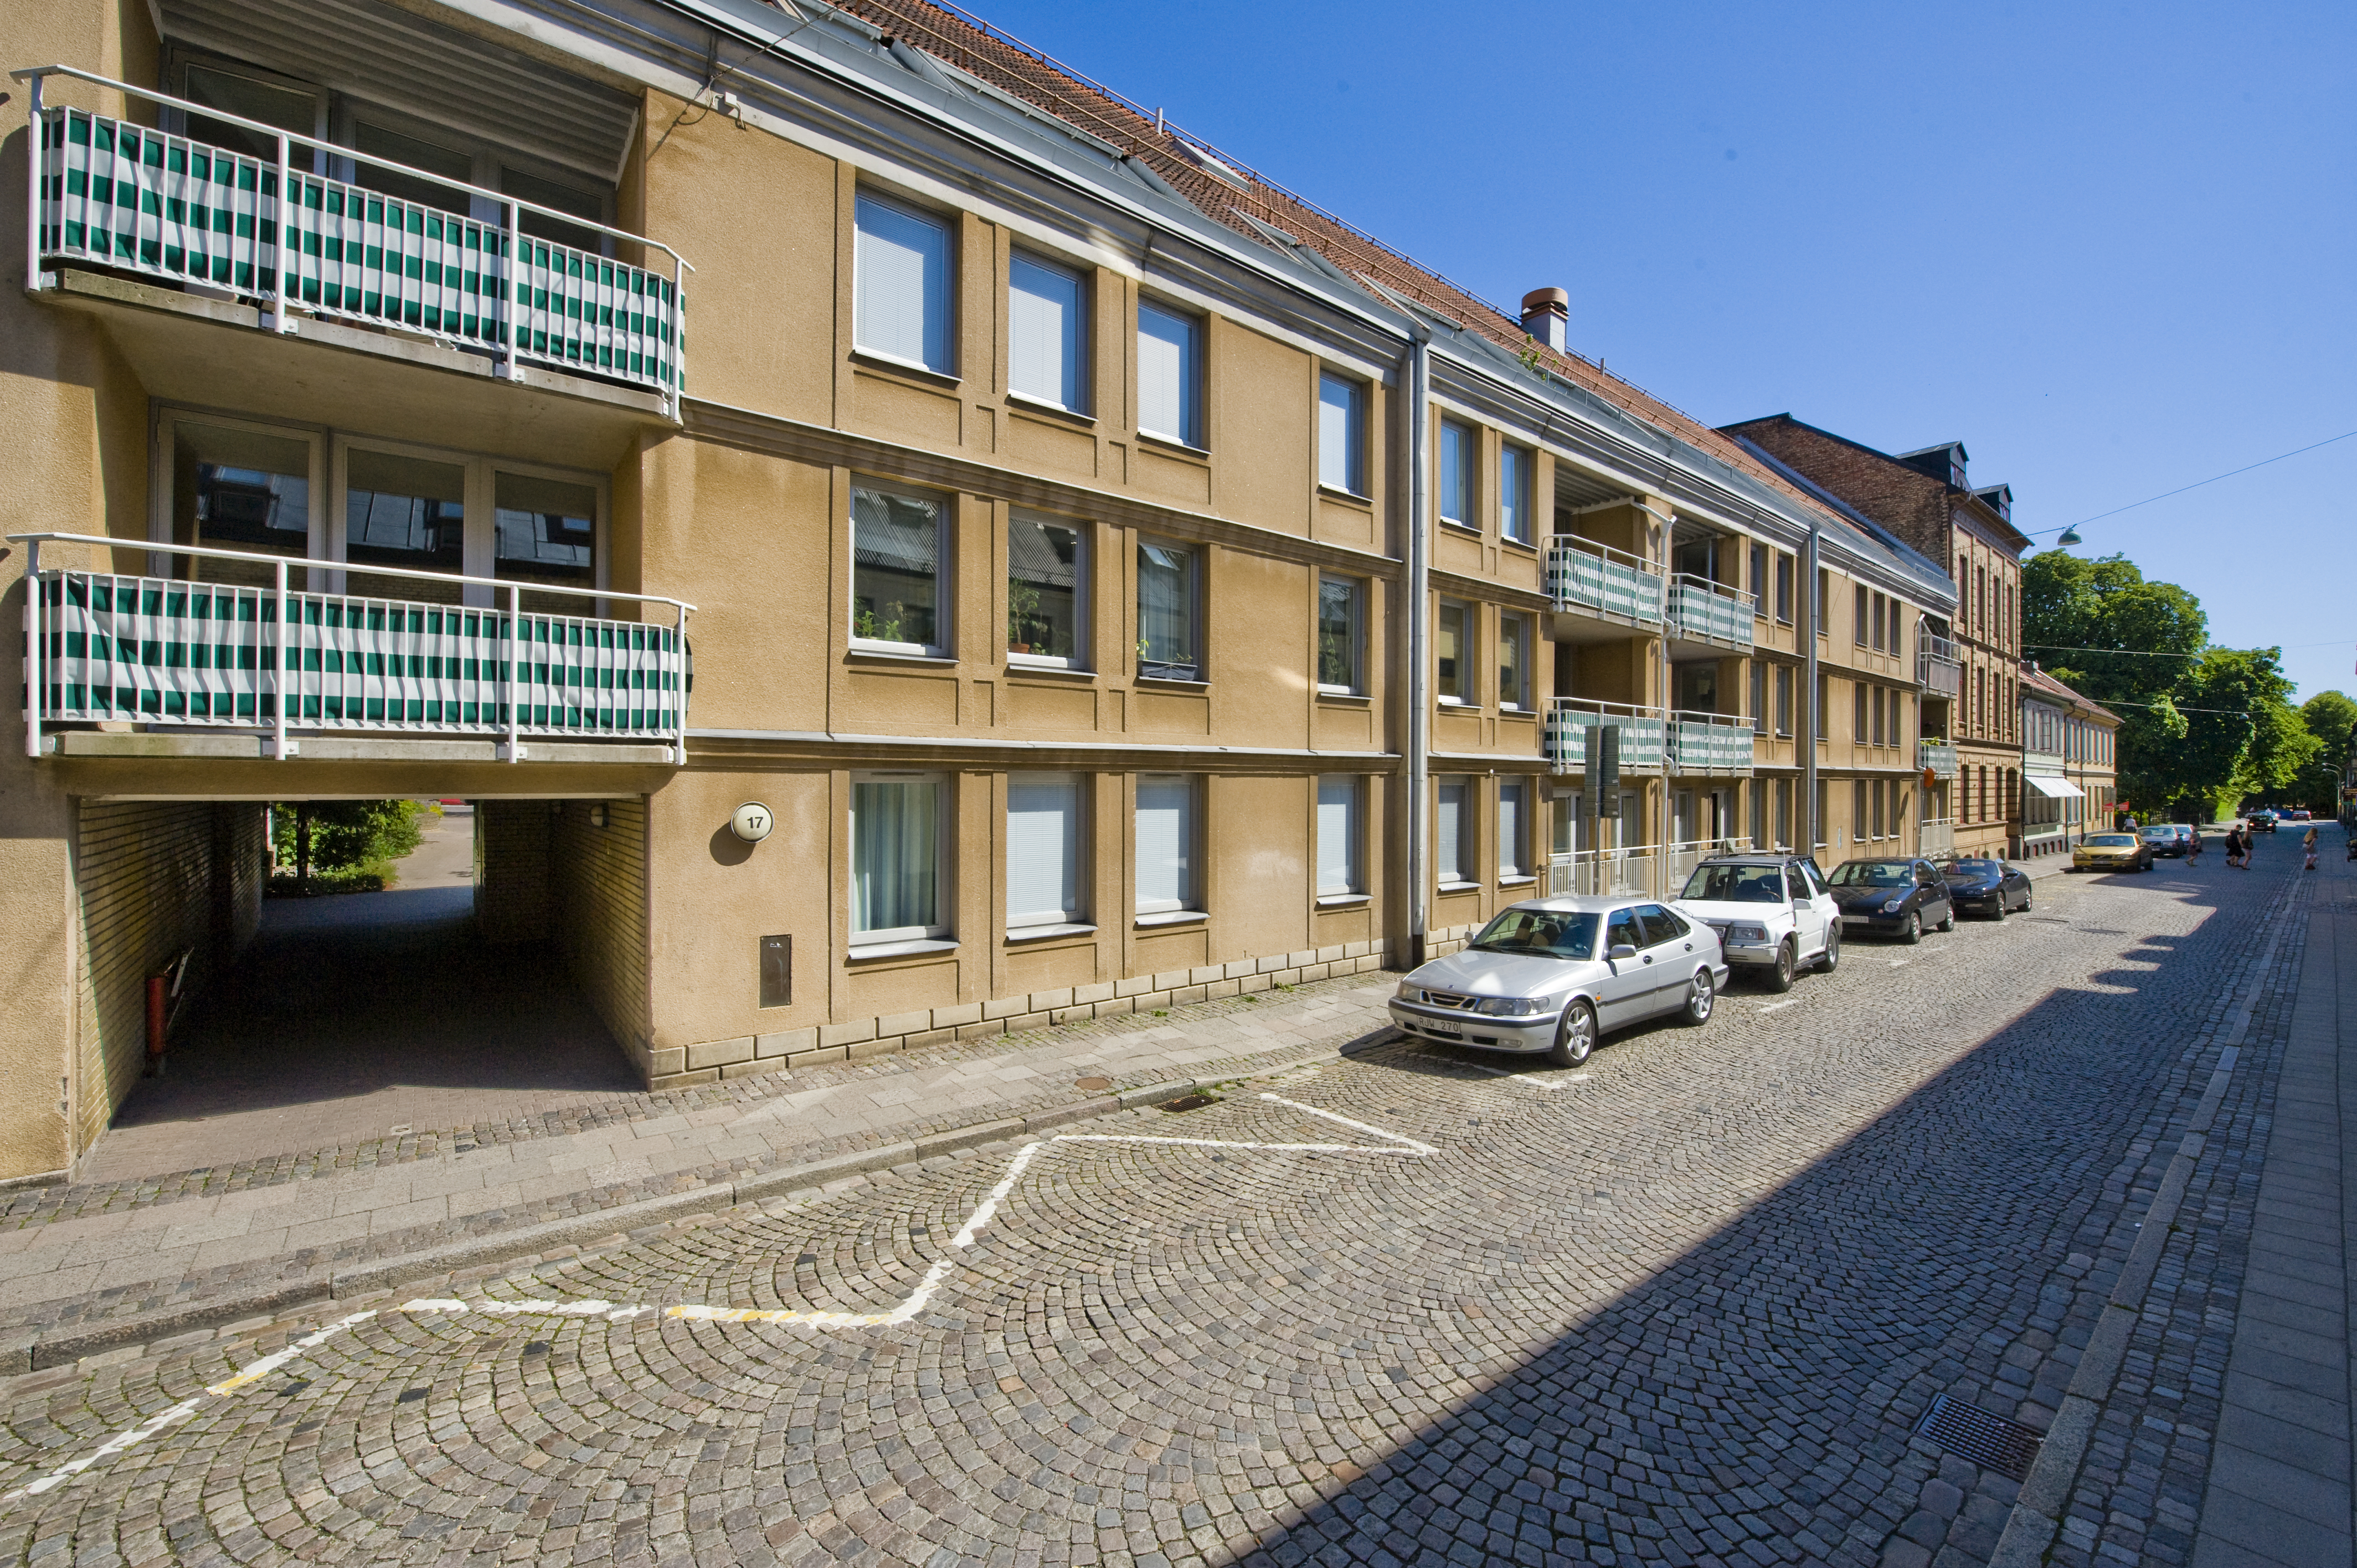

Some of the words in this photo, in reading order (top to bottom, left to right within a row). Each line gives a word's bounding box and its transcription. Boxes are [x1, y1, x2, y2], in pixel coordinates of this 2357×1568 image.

[747, 817, 763, 828] 17
[1419, 1017, 1434, 1028] RJW
[1441, 1022, 1458, 1032] 270
